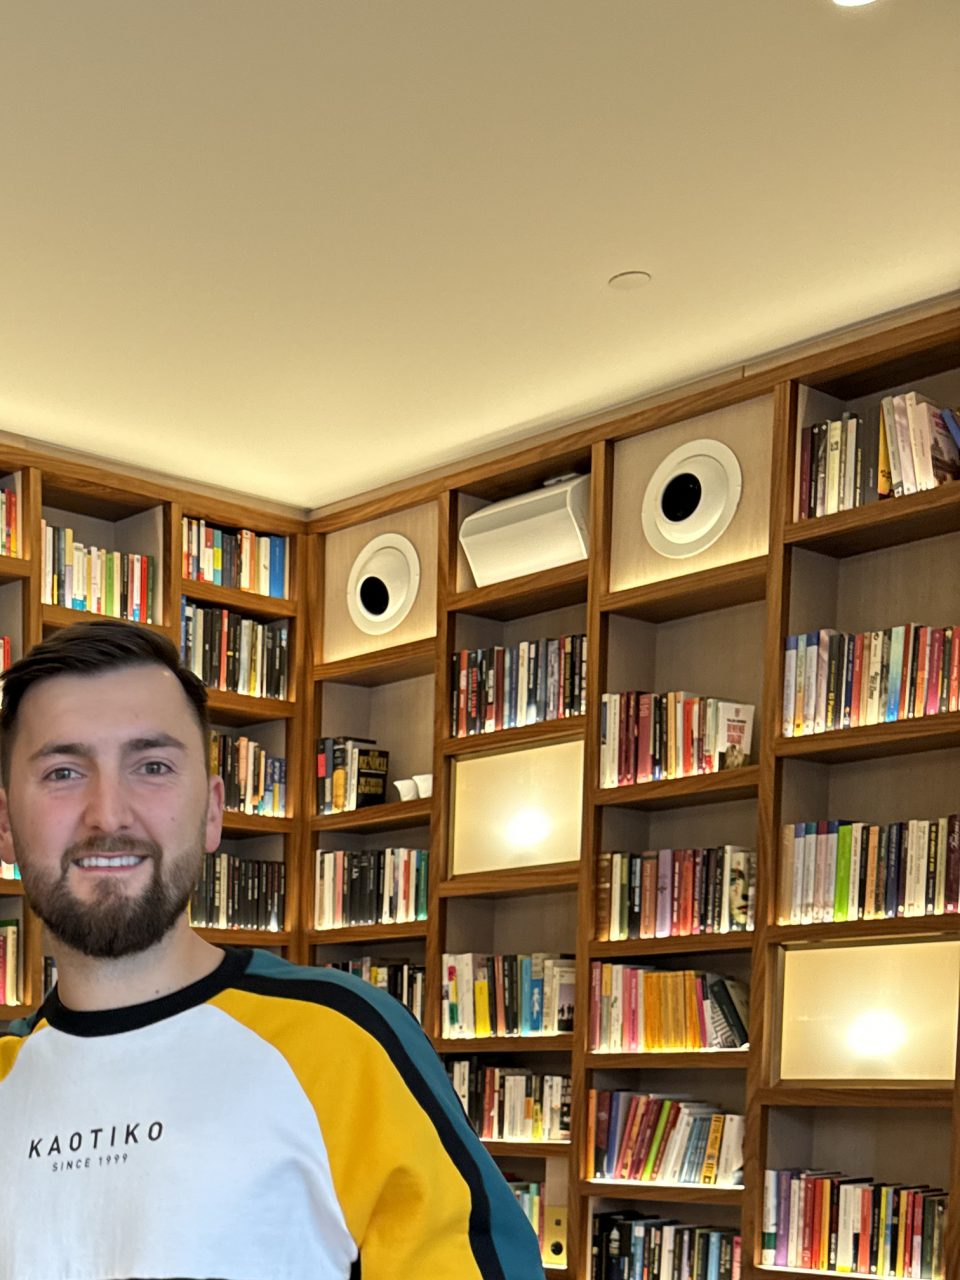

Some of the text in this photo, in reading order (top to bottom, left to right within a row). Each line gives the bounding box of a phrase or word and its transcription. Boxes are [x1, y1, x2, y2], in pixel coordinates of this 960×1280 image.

[28, 1121, 163, 1159] KAOTIKO
[51, 1153, 128, 1172] SINCE 1999
